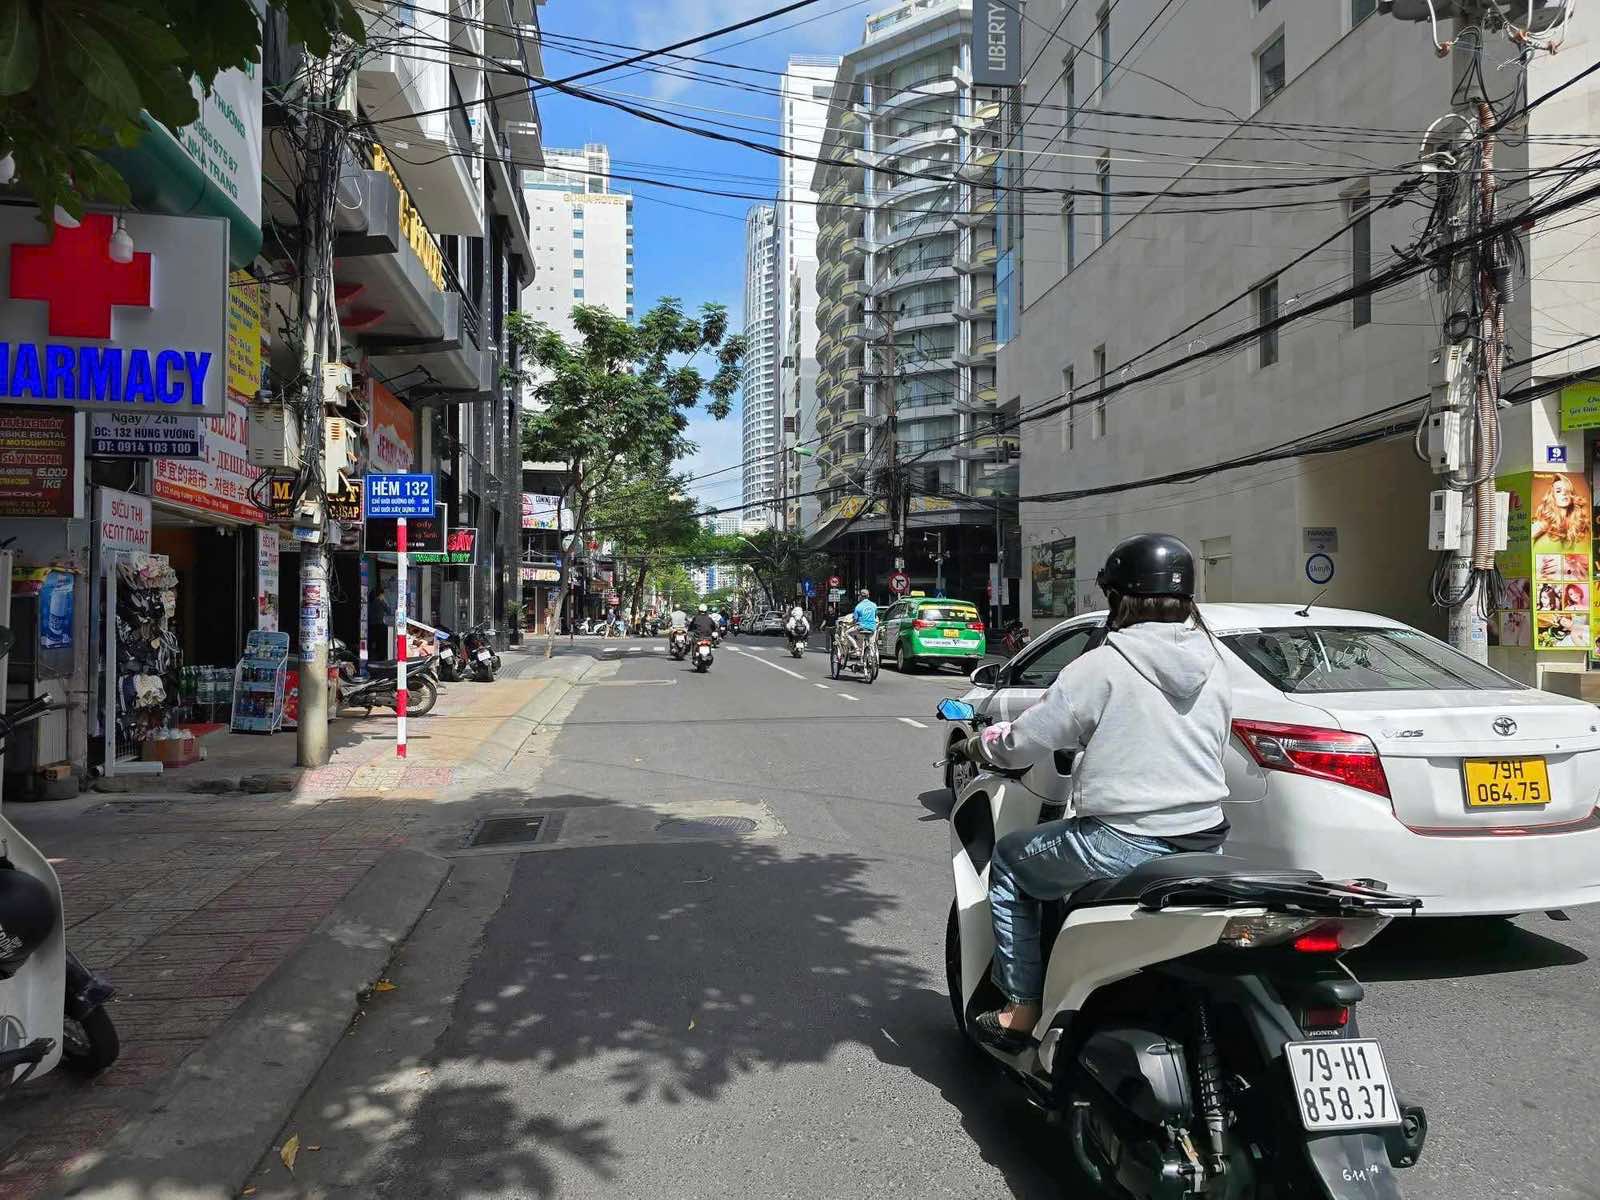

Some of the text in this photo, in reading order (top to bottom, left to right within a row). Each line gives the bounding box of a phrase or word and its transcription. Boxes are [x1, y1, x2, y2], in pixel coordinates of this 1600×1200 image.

[988, 3, 1006, 71] LIBERTY
[188, 135, 208, 169] NHA
[208, 157, 238, 199] TRANG
[0, 342, 212, 405] ARMACY
[30, 431, 66, 439] RENTAL
[115, 428, 132, 438] 132
[117, 441, 144, 452] 0914
[148, 442, 168, 453] 103
[172, 442, 191, 453] 100
[1552, 447, 1562, 458] 9
[372, 477, 400, 496] HẺM
[405, 481, 429, 496] 132
[1488, 761, 1524, 780] 79H
[1477, 781, 1541, 803] 064.75
[1308, 1029, 1340, 1037] HONDA
[1302, 1046, 1371, 1082] 79-H1
[1303, 1084, 1386, 1122] 858.37
